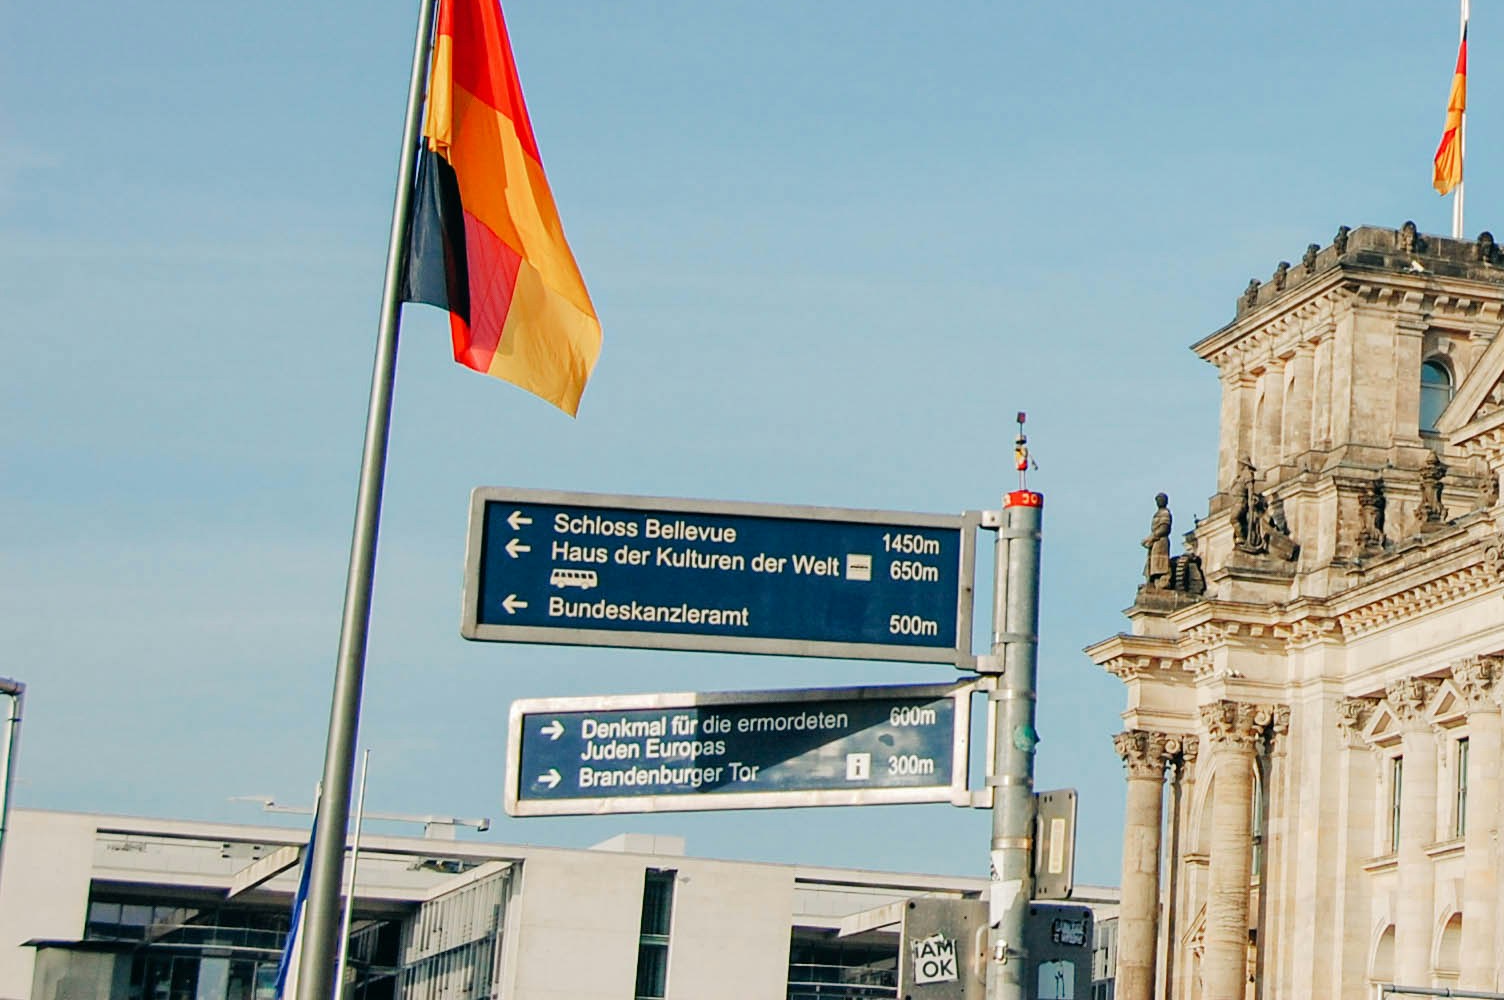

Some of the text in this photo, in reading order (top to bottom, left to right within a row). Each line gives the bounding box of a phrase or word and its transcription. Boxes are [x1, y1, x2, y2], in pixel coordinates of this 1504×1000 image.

[554, 513, 736, 543] Schloss Bellevue
[882, 533, 940, 555] 1450m
[552, 541, 839, 577] Haus der Kulturen der Welt
[890, 561, 939, 582] 650m
[549, 597, 749, 627] Bundeskanzleramt
[889, 615, 938, 636] 500m
[581, 711, 848, 739] Denkmal für die ermordeten
[890, 707, 936, 726] 600m
[581, 739, 726, 761] Juden Europas
[579, 762, 760, 787] Brandenburger Tor
[888, 755, 934, 775] 300m
[922, 959, 954, 978] OK
